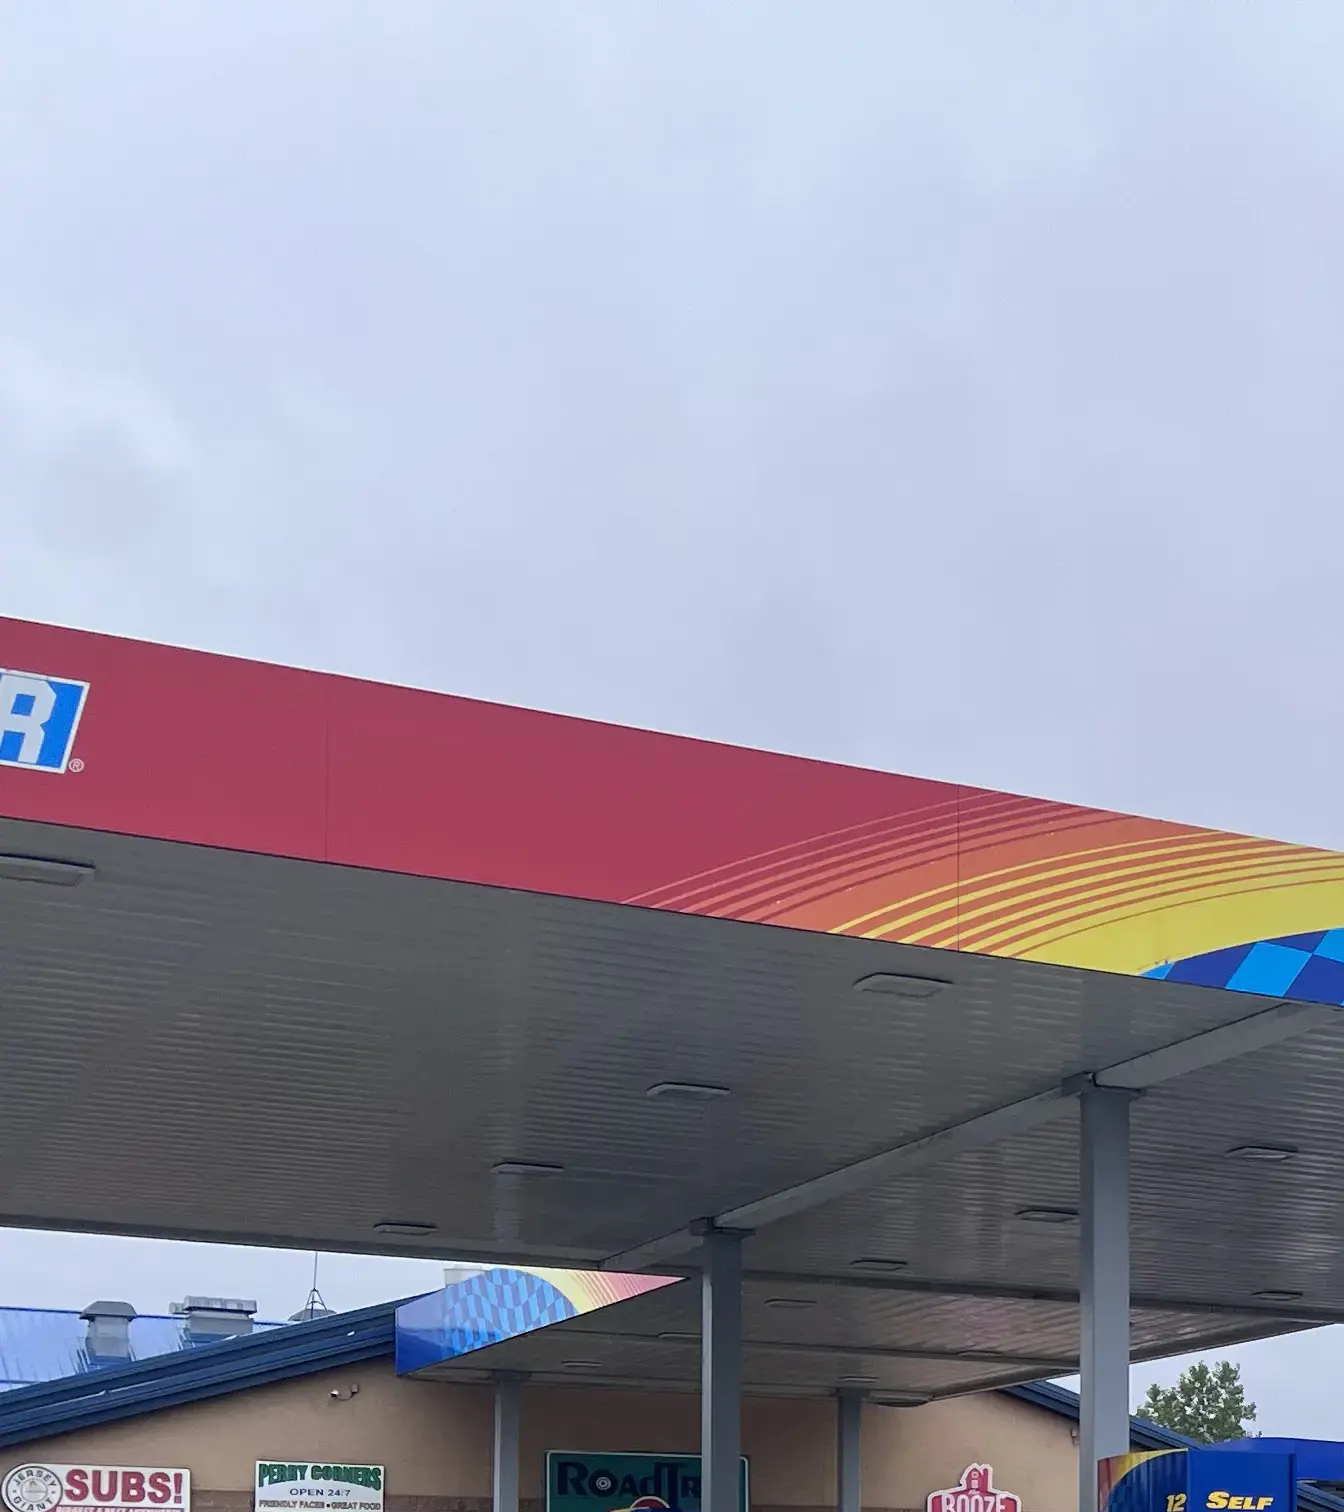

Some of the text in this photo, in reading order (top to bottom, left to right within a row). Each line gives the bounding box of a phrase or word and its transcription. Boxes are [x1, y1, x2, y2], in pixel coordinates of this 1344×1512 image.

[15, 1468, 57, 1487] JERSEY
[64, 1468, 183, 1505] SUBS!
[258, 1463, 382, 1491] PERRY CORNERS
[289, 1488, 351, 1497] OPEN 24/7
[1205, 1491, 1274, 1511] SELF
[13, 1496, 53, 1512] GIANT
[1166, 1493, 1187, 1512] 12
